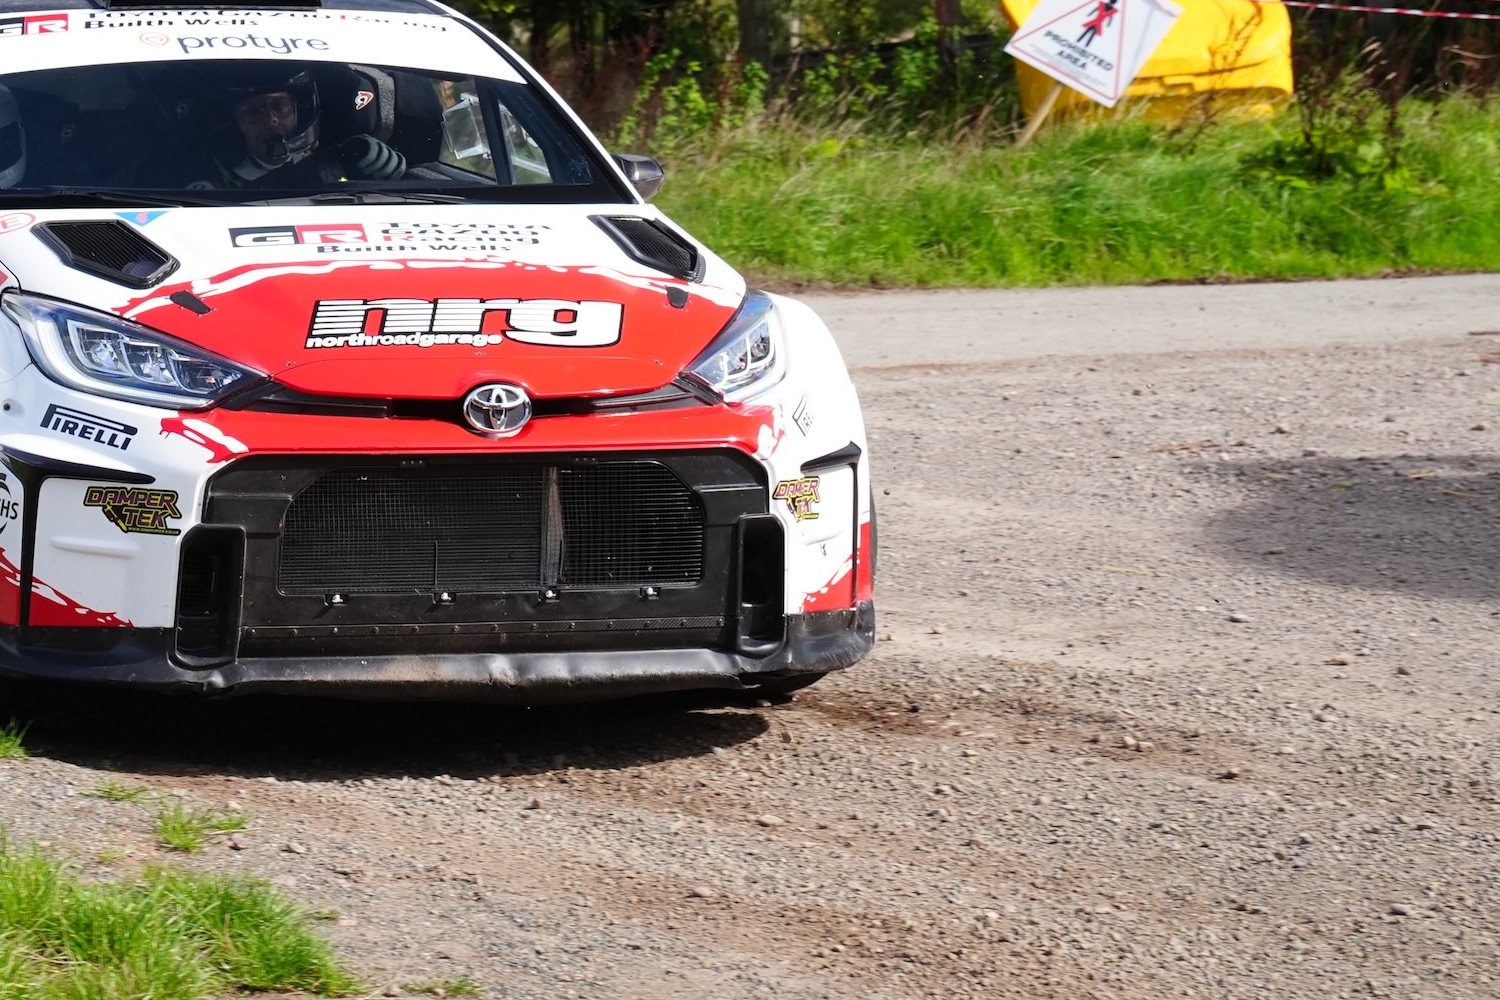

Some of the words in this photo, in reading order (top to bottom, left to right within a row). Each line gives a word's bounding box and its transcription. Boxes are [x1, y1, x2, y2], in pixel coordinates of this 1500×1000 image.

[84, 18, 174, 29] Builth
[176, 33, 330, 55] protyre
[1044, 30, 1114, 71] PROHIBITED
[1057, 50, 1087, 70] AREA
[0, 216, 21, 230] E
[378, 222, 553, 231] TOYOTA
[231, 225, 368, 247] GR
[383, 235, 540, 245] Racing
[316, 245, 417, 254] Builth
[310, 298, 625, 348] nrg
[304, 331, 503, 349] northroadgarage
[40, 403, 138, 451] PIRELLI
[85, 487, 181, 519] DAMPER
[122, 507, 169, 529] TEK
